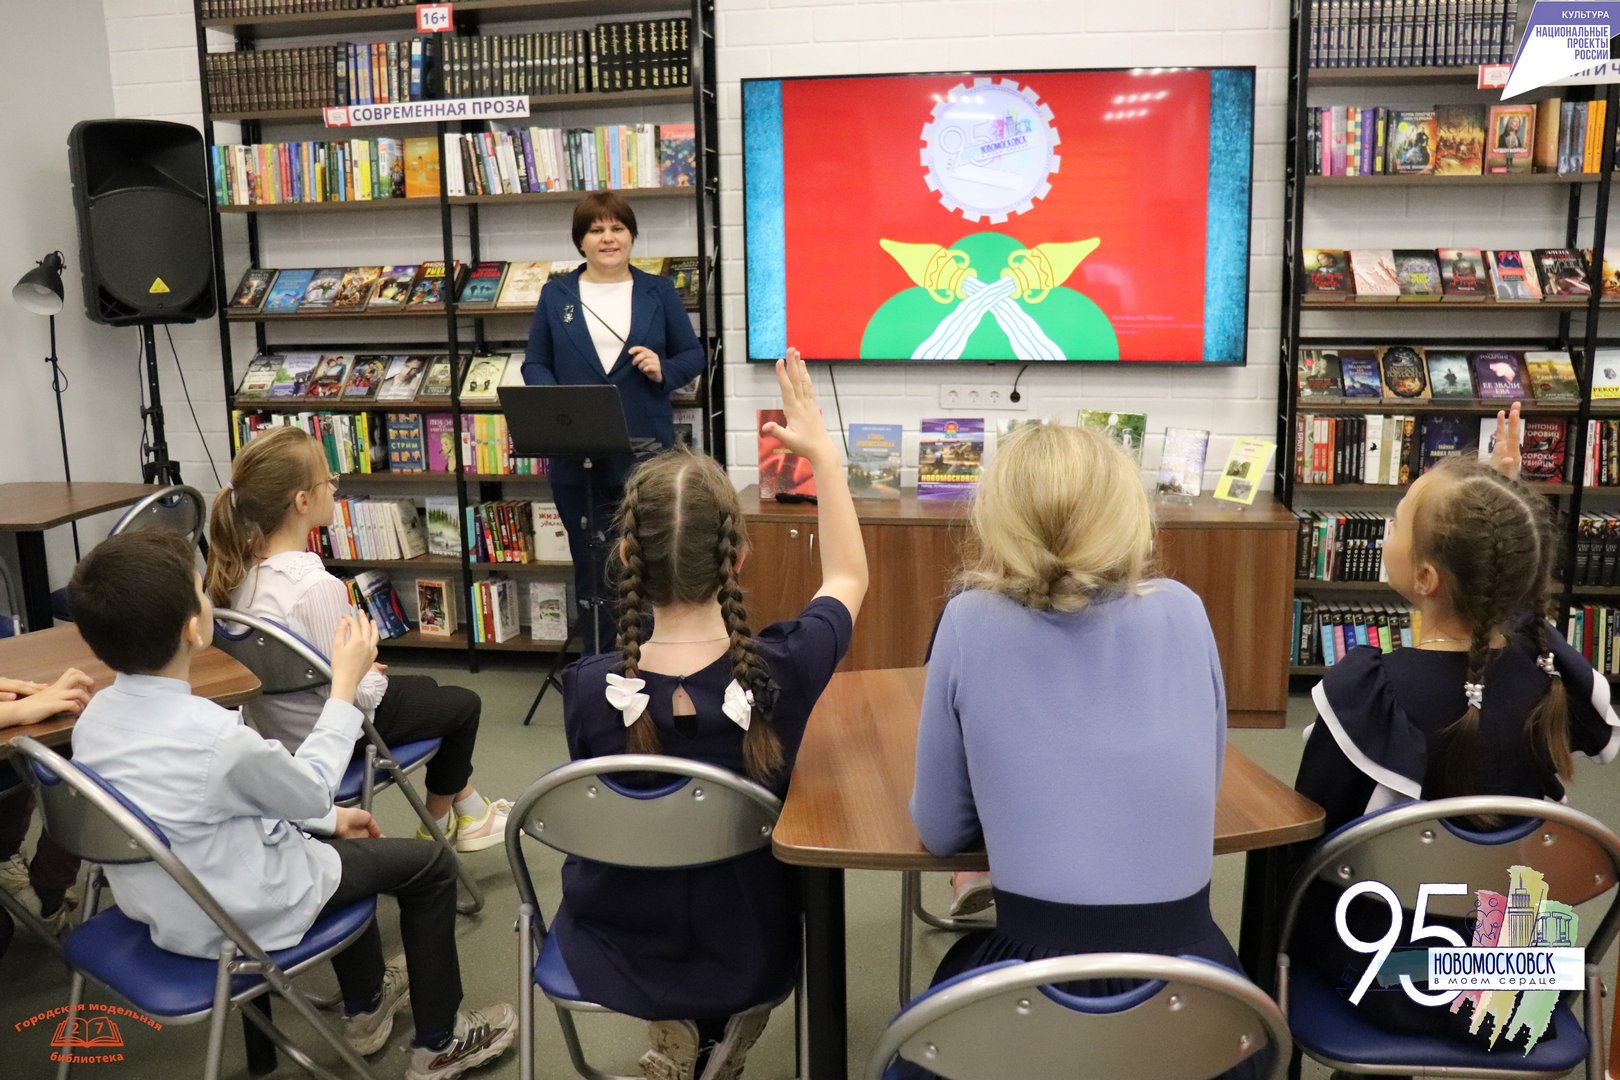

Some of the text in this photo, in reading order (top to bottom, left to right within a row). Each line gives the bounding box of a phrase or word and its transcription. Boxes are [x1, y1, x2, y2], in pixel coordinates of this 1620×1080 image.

[422, 12, 447, 25] 16+
[352, 99, 526, 122] СОВРЕМЕННАЯ ПРОЗА
[390, 441, 418, 449] СТРИМ
[921, 474, 979, 483] НОВОМОСКОВС
